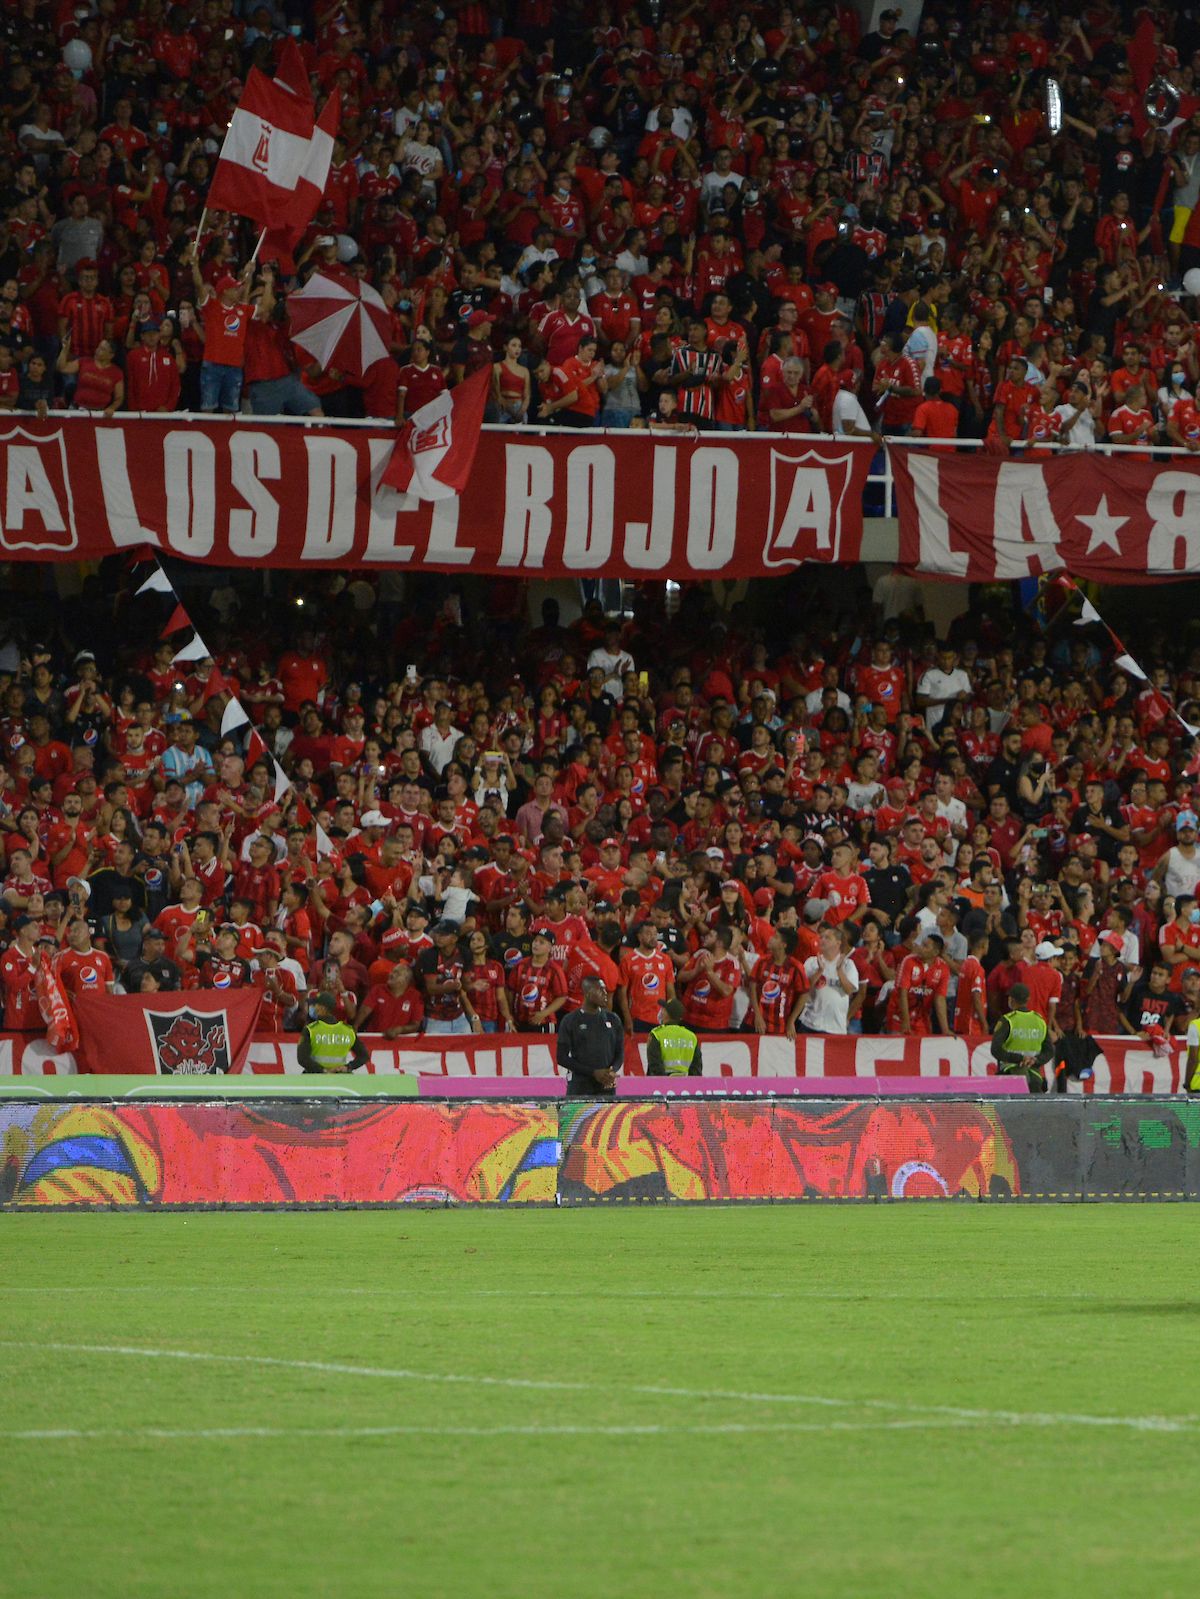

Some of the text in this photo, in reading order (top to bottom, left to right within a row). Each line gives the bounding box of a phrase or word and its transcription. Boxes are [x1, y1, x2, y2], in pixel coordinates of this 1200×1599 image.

[5, 444, 67, 532] A
[95, 426, 740, 570] LOS DEL ROJO
[773, 466, 832, 550] A
[906, 453, 1067, 579] LA
